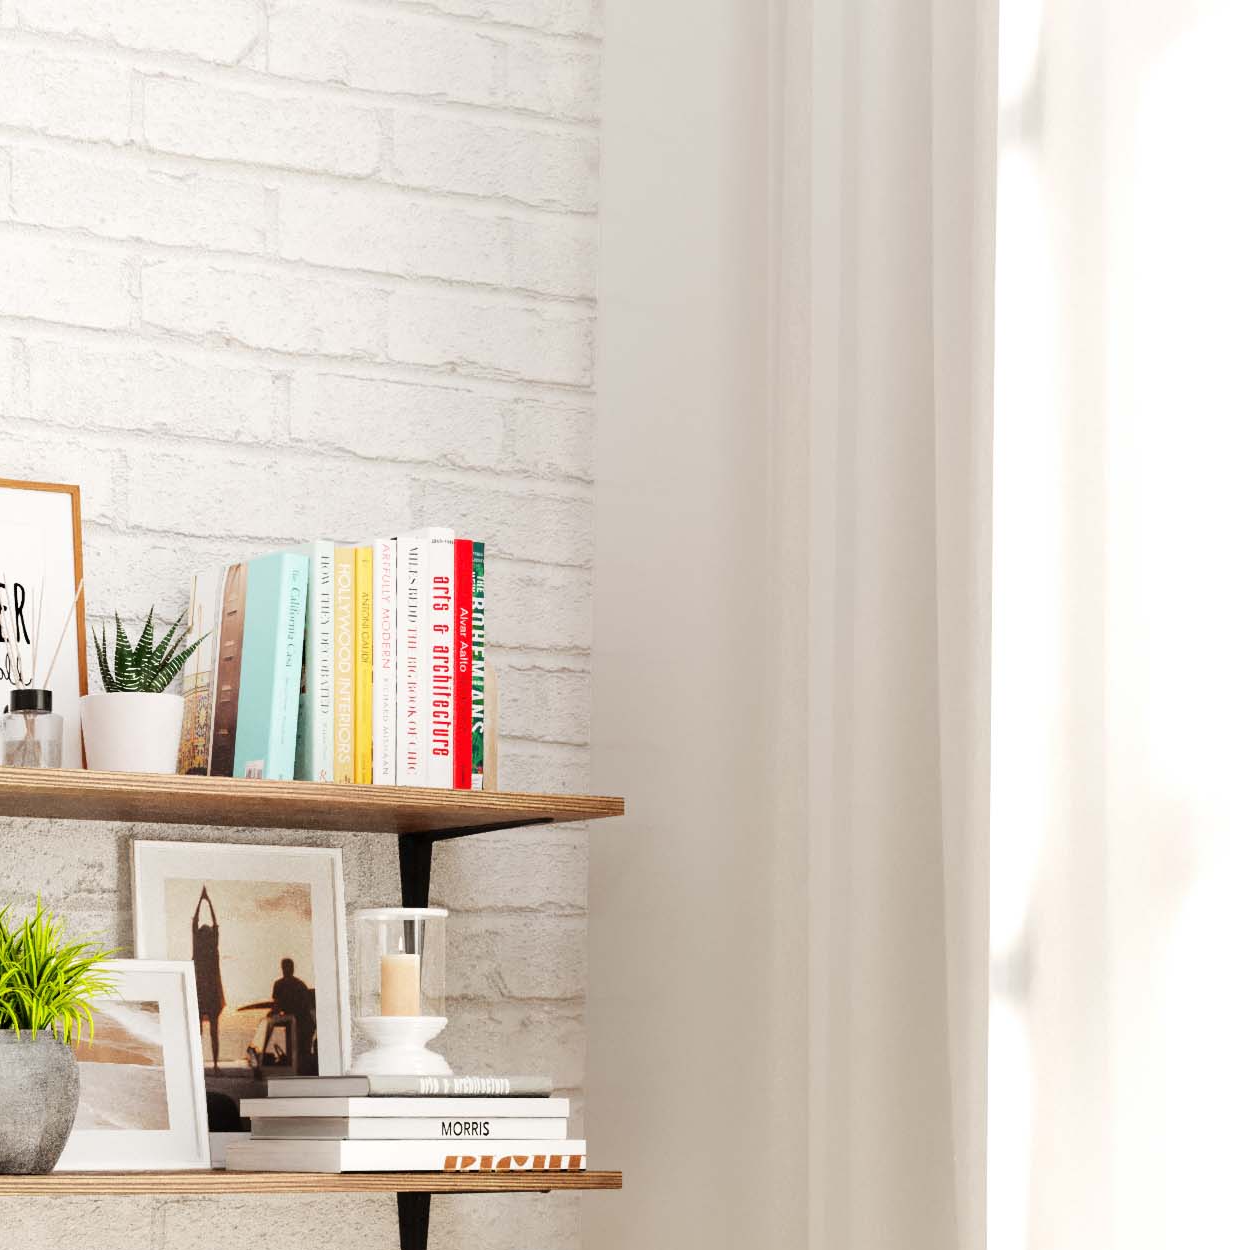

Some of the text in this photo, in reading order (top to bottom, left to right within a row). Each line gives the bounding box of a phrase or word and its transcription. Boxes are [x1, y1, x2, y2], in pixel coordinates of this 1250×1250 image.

[320, 556, 331, 584] HOW
[381, 543, 391, 603] ARTFULLY
[320, 593, 331, 625] THEY
[360, 592, 370, 629] ANTONI
[381, 608, 391, 670] MODERN
[337, 563, 351, 764] HOLLYWOOD INTERIORS
[433, 576, 452, 757] arts & architecture
[459, 608, 469, 674] Alvar Aalto
[471, 597, 485, 734] BOHEMIANS
[320, 632, 331, 715] DECORATED
[407, 681, 418, 719] BOOK
[381, 726, 390, 776] MISHAAN
[441, 1121, 490, 1137] MORRIS
